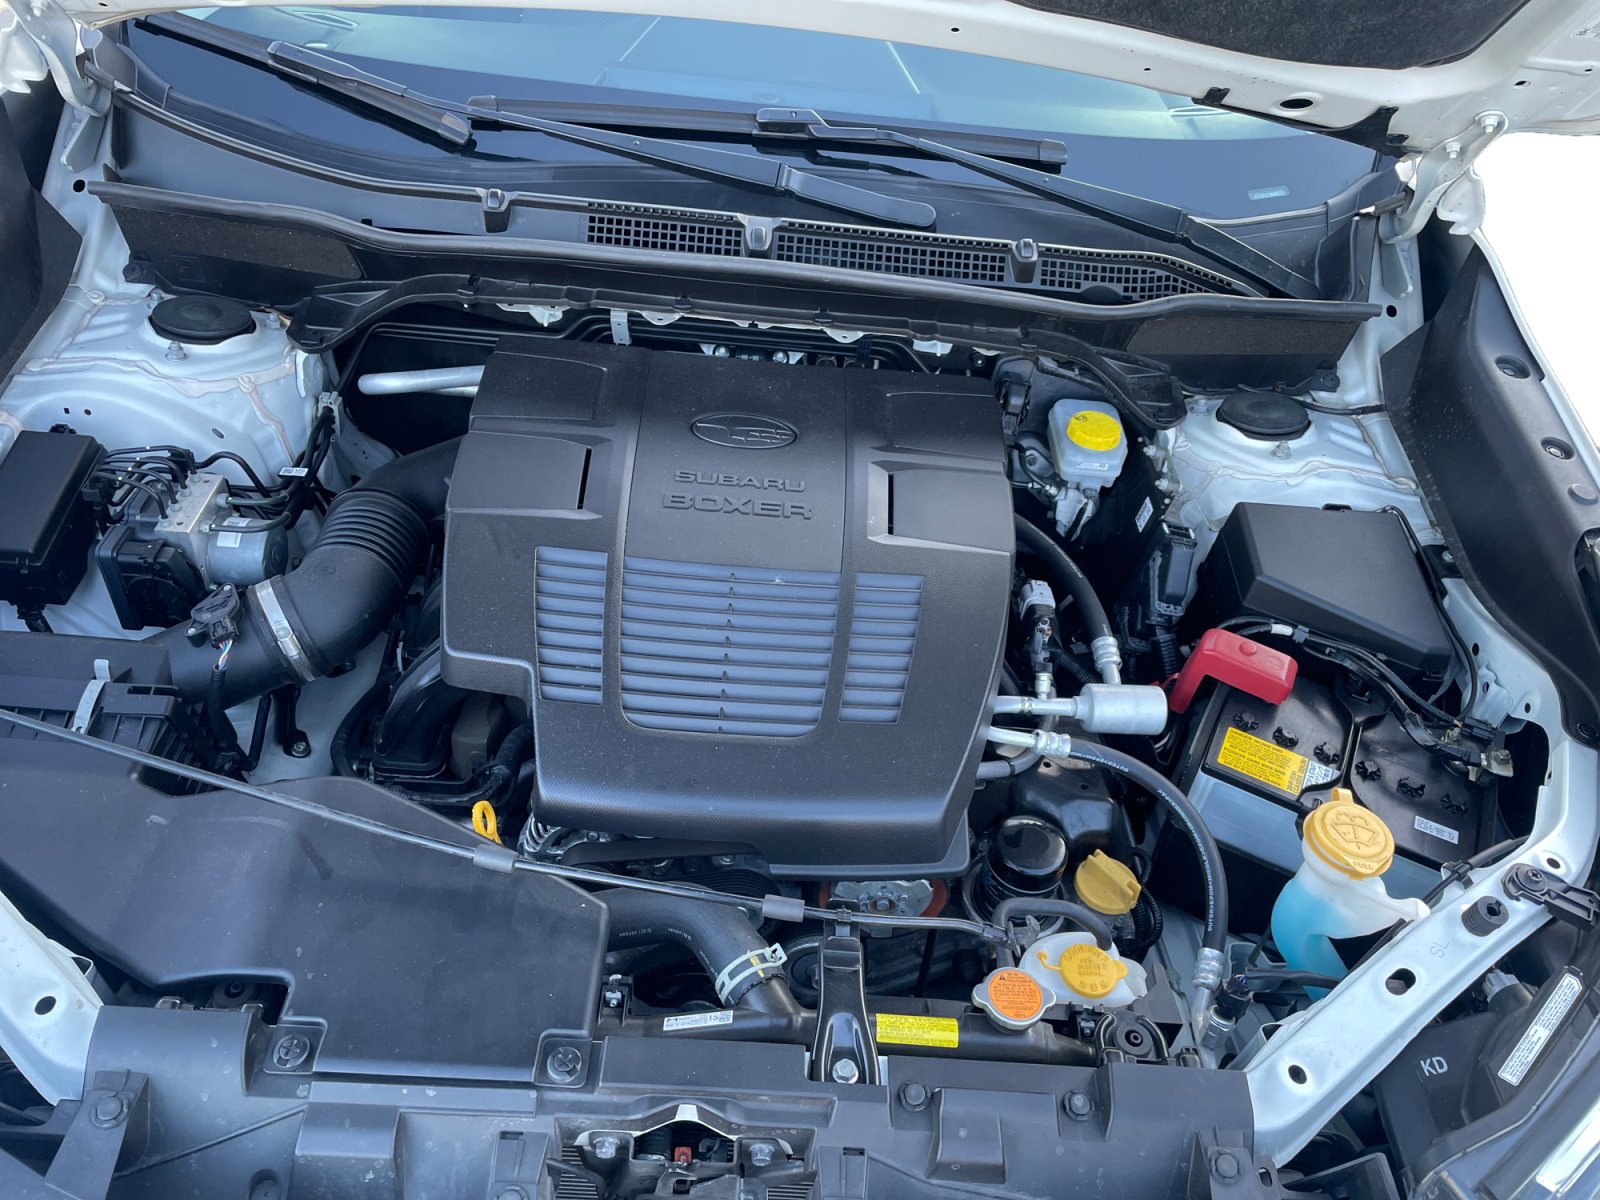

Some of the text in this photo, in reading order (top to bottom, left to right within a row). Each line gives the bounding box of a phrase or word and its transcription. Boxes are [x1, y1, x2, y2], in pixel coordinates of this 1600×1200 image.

[674, 469, 805, 492] SUBARU
[662, 492, 813, 520] BOXER
[1223, 746, 1246, 759] POISON
[1420, 1057, 1448, 1076] KD
